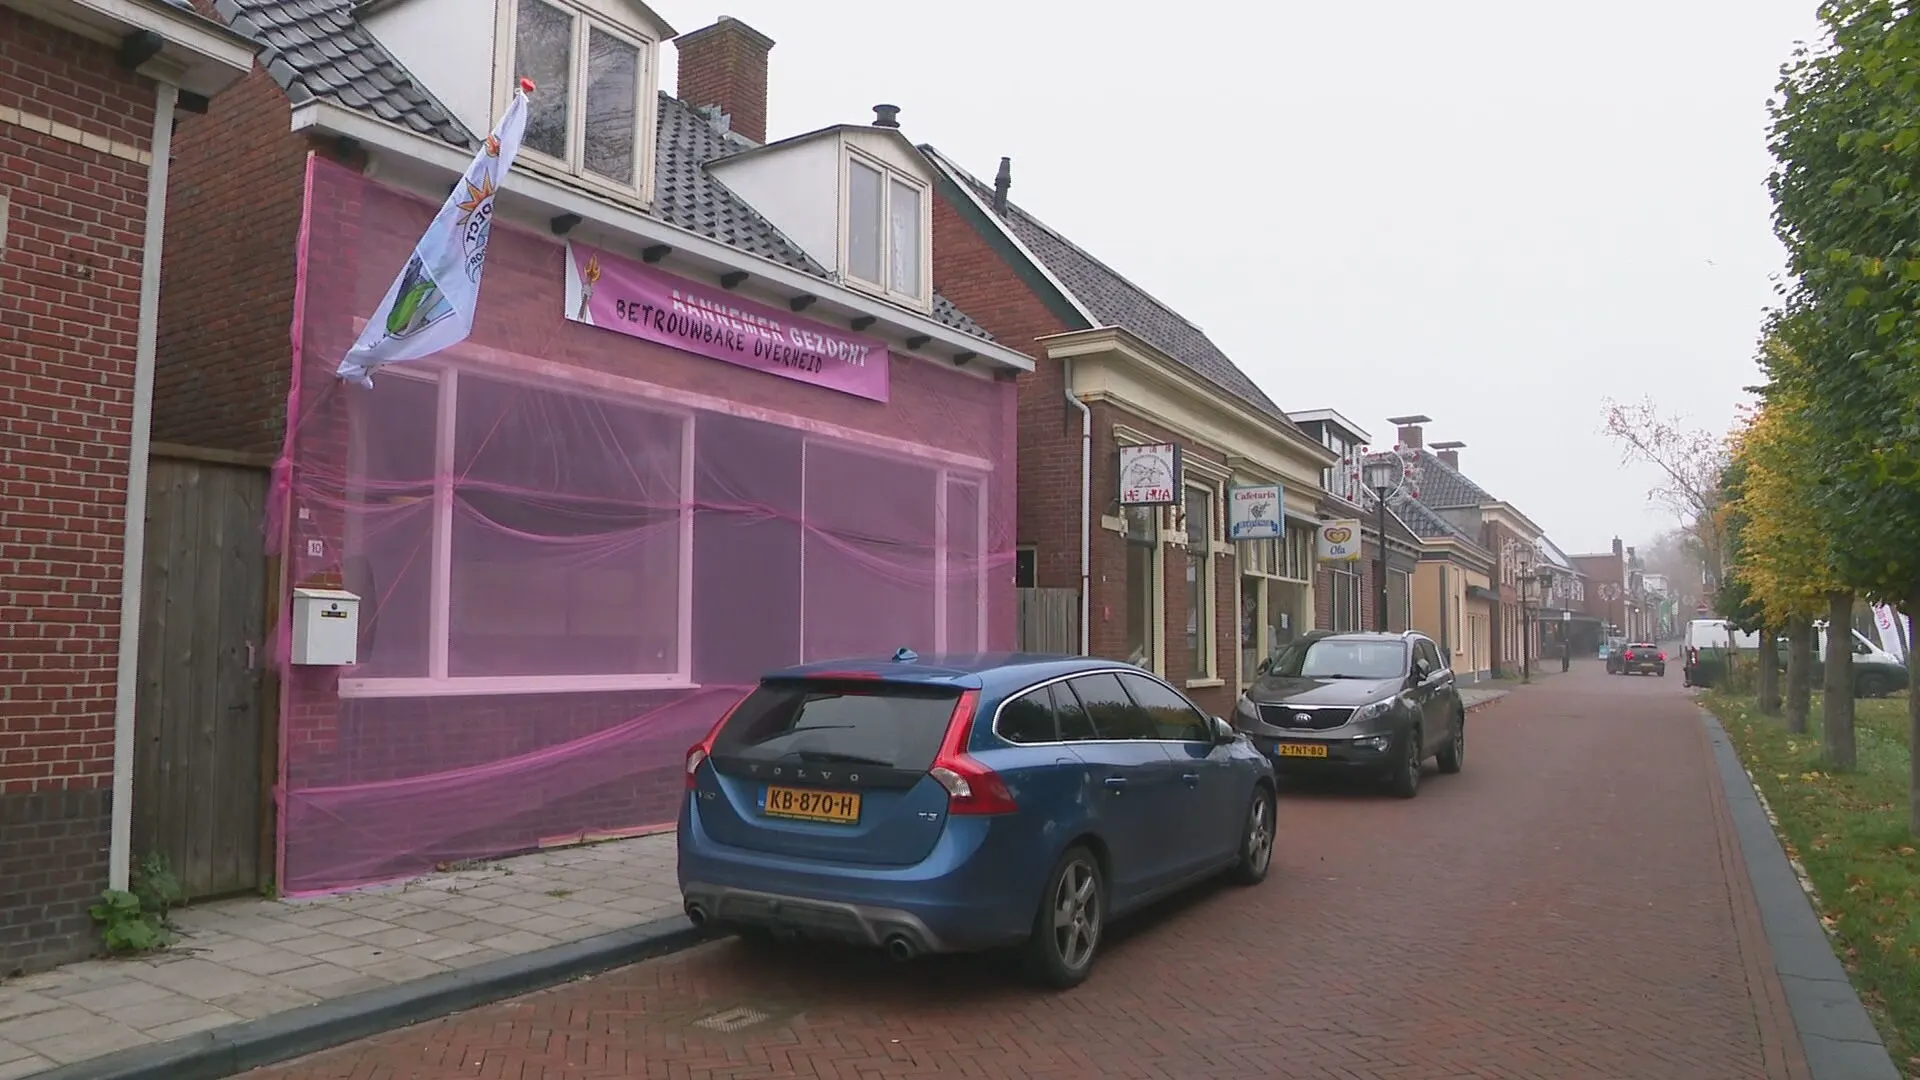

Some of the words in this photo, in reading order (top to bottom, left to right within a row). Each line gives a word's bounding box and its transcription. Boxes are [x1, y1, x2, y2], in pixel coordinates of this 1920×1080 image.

[616, 299, 745, 352] BETROUWBARE
[754, 338, 823, 374] OVERHEID
[672, 289, 784, 343] AANNEMER
[789, 326, 869, 367] GEZOCHT
[1235, 490, 1276, 501] Cafetaria
[1330, 544, 1346, 556] Ola
[749, 764, 859, 782] VOLVO
[769, 788, 854, 817] KB-870-H
